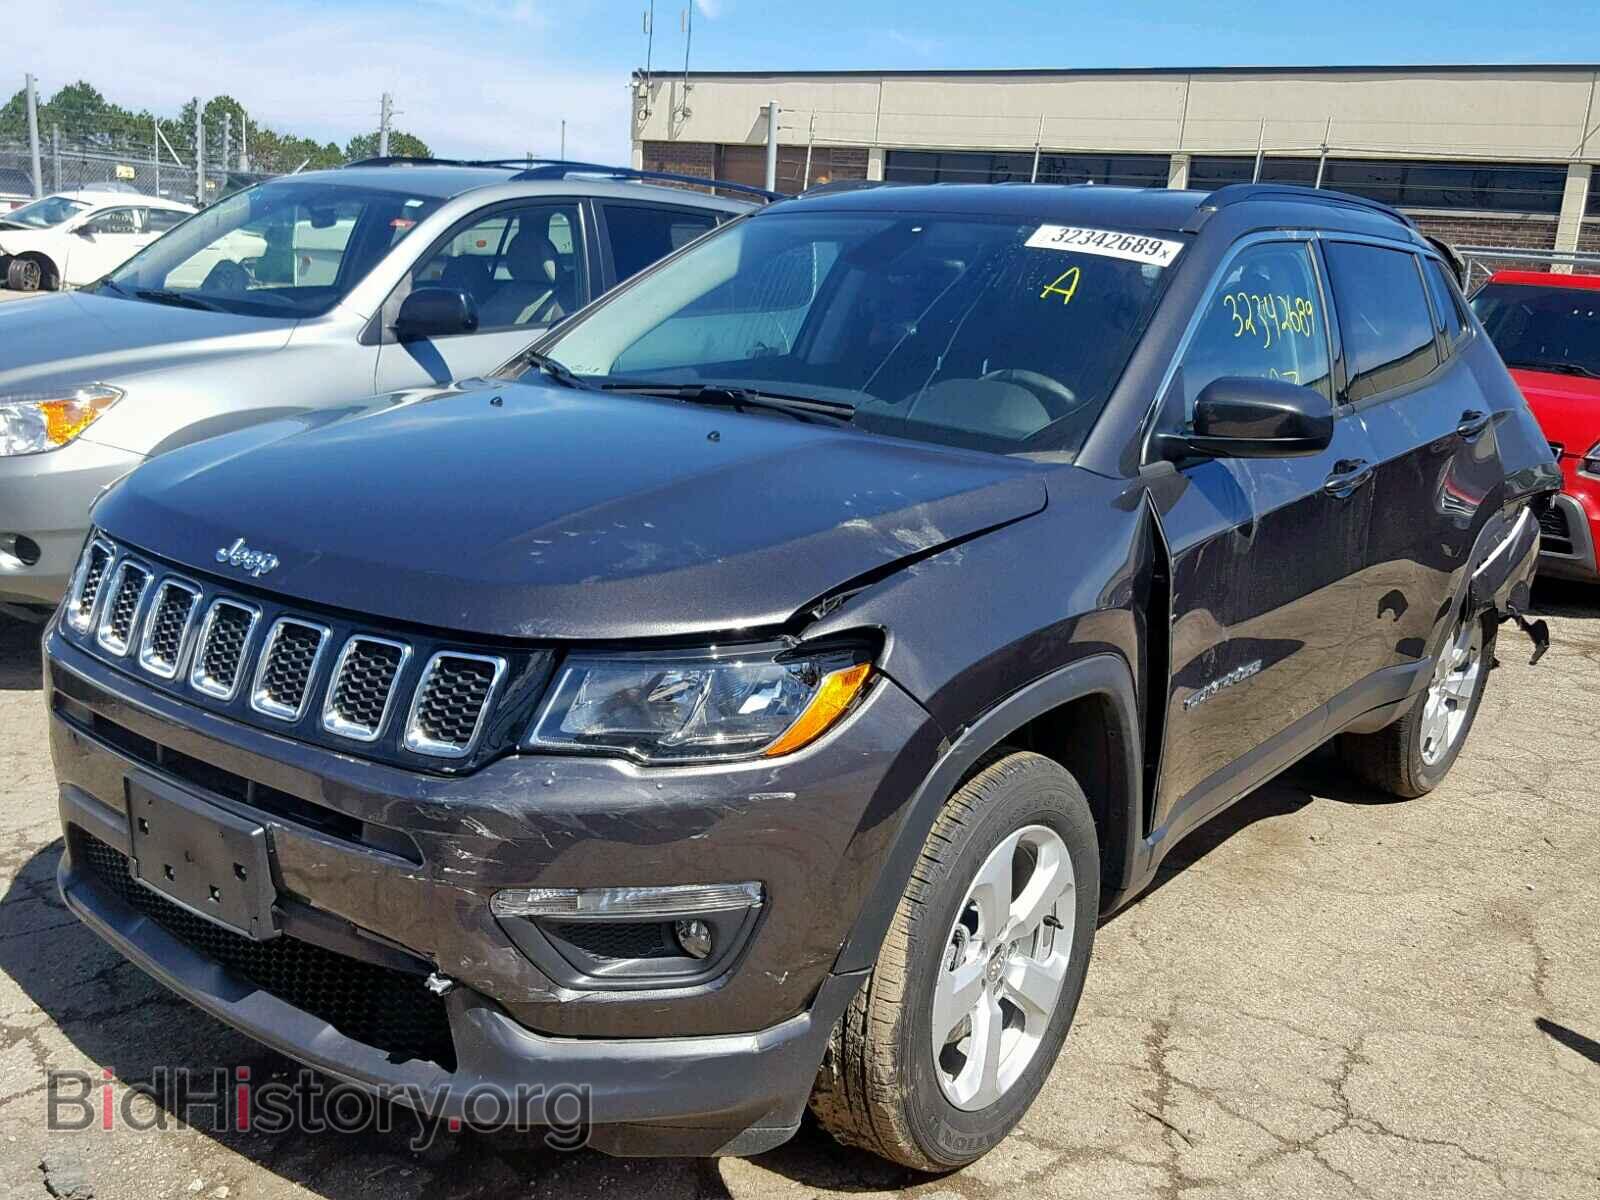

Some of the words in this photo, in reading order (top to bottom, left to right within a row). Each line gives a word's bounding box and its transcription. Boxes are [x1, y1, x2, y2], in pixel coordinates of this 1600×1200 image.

[1039, 266, 1080, 305] A
[1223, 292, 1315, 349] 32342689
[215, 536, 281, 577] Jeep
